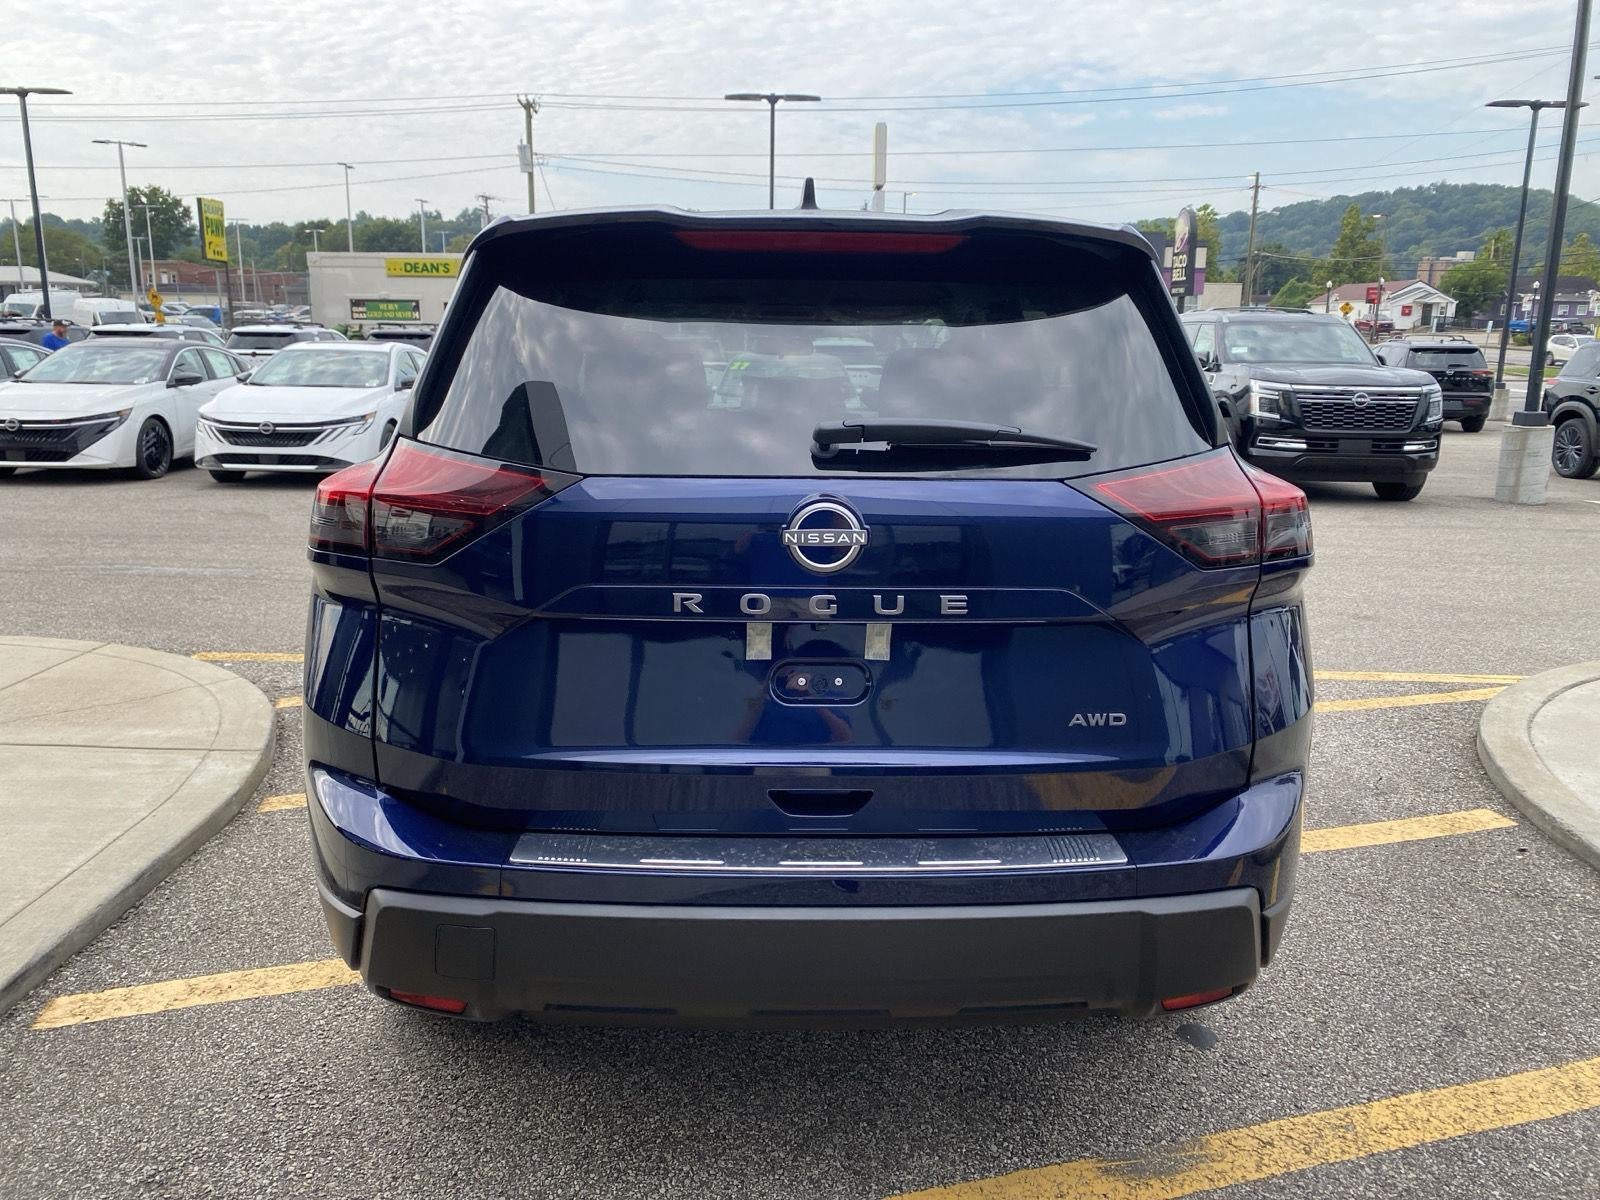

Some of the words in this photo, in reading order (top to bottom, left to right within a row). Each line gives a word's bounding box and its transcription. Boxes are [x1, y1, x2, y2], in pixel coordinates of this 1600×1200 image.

[1172, 254, 1187, 268] TACO
[1171, 268, 1187, 282] BELL
[783, 532, 867, 545] NISSAN
[672, 591, 969, 616] ROGUE
[1067, 711, 1128, 728] AWD
